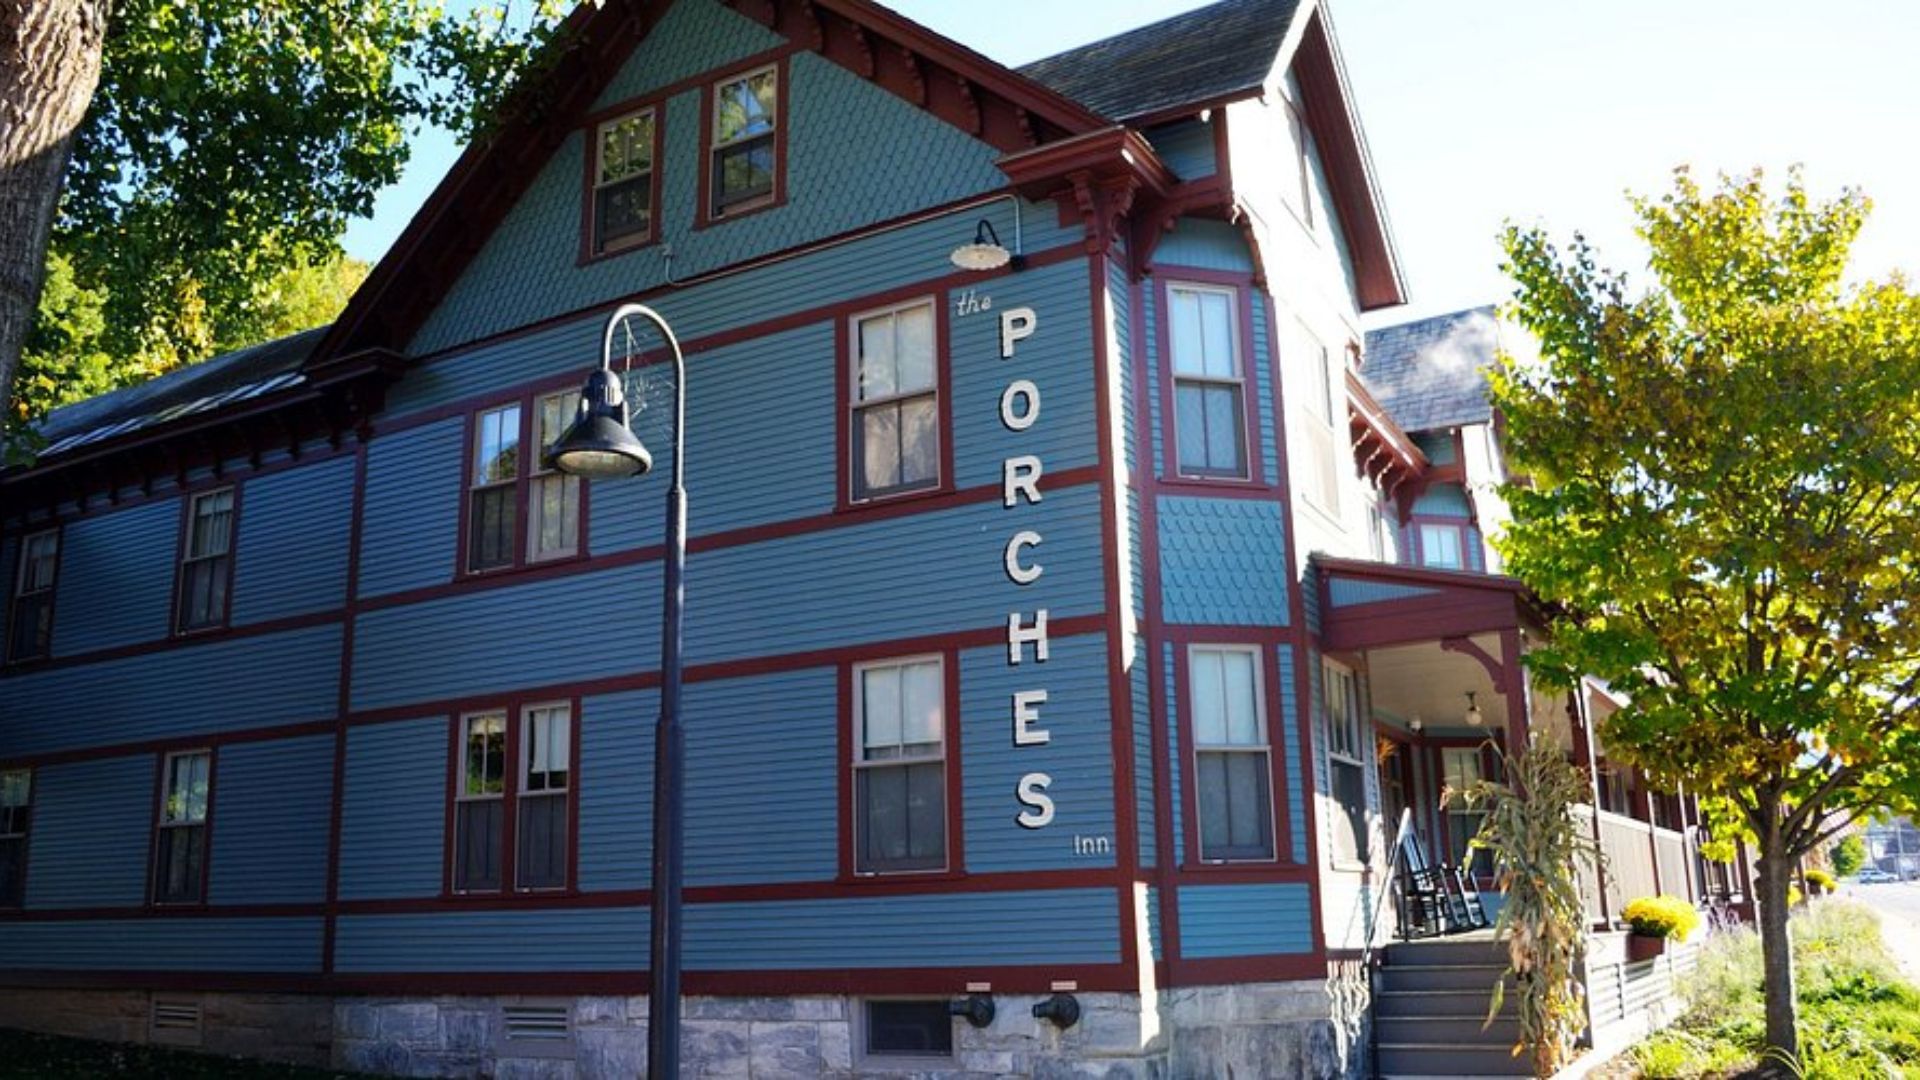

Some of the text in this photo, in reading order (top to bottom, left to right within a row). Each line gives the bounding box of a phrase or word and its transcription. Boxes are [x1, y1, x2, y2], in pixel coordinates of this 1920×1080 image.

[956, 291, 992, 317] the
[1000, 306, 1056, 829] PORCHES
[1073, 834, 1110, 854] Inn
